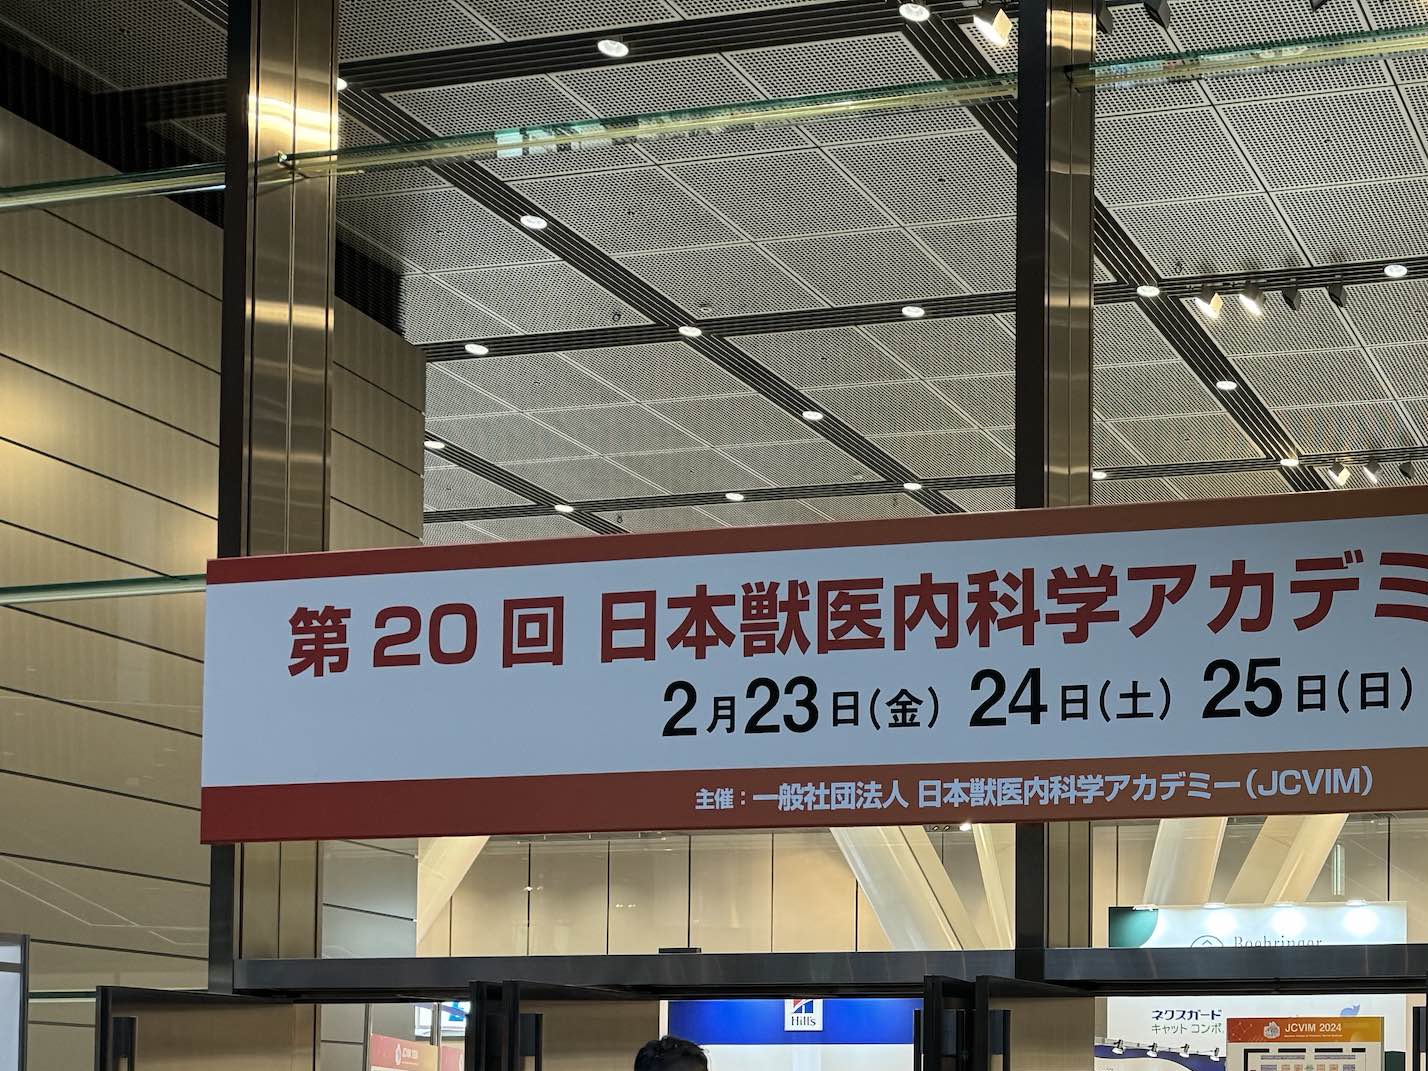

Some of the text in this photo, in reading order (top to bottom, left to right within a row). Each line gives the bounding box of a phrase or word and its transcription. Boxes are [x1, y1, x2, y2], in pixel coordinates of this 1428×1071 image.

[662, 657, 1412, 736] 2月23日(金) 24日(土) 25日(日)
[791, 1015, 816, 1026] Hill's
[1151, 1009, 1222, 1021] ネクスガード
[1285, 1023, 1342, 1032] JCVIM 2024
